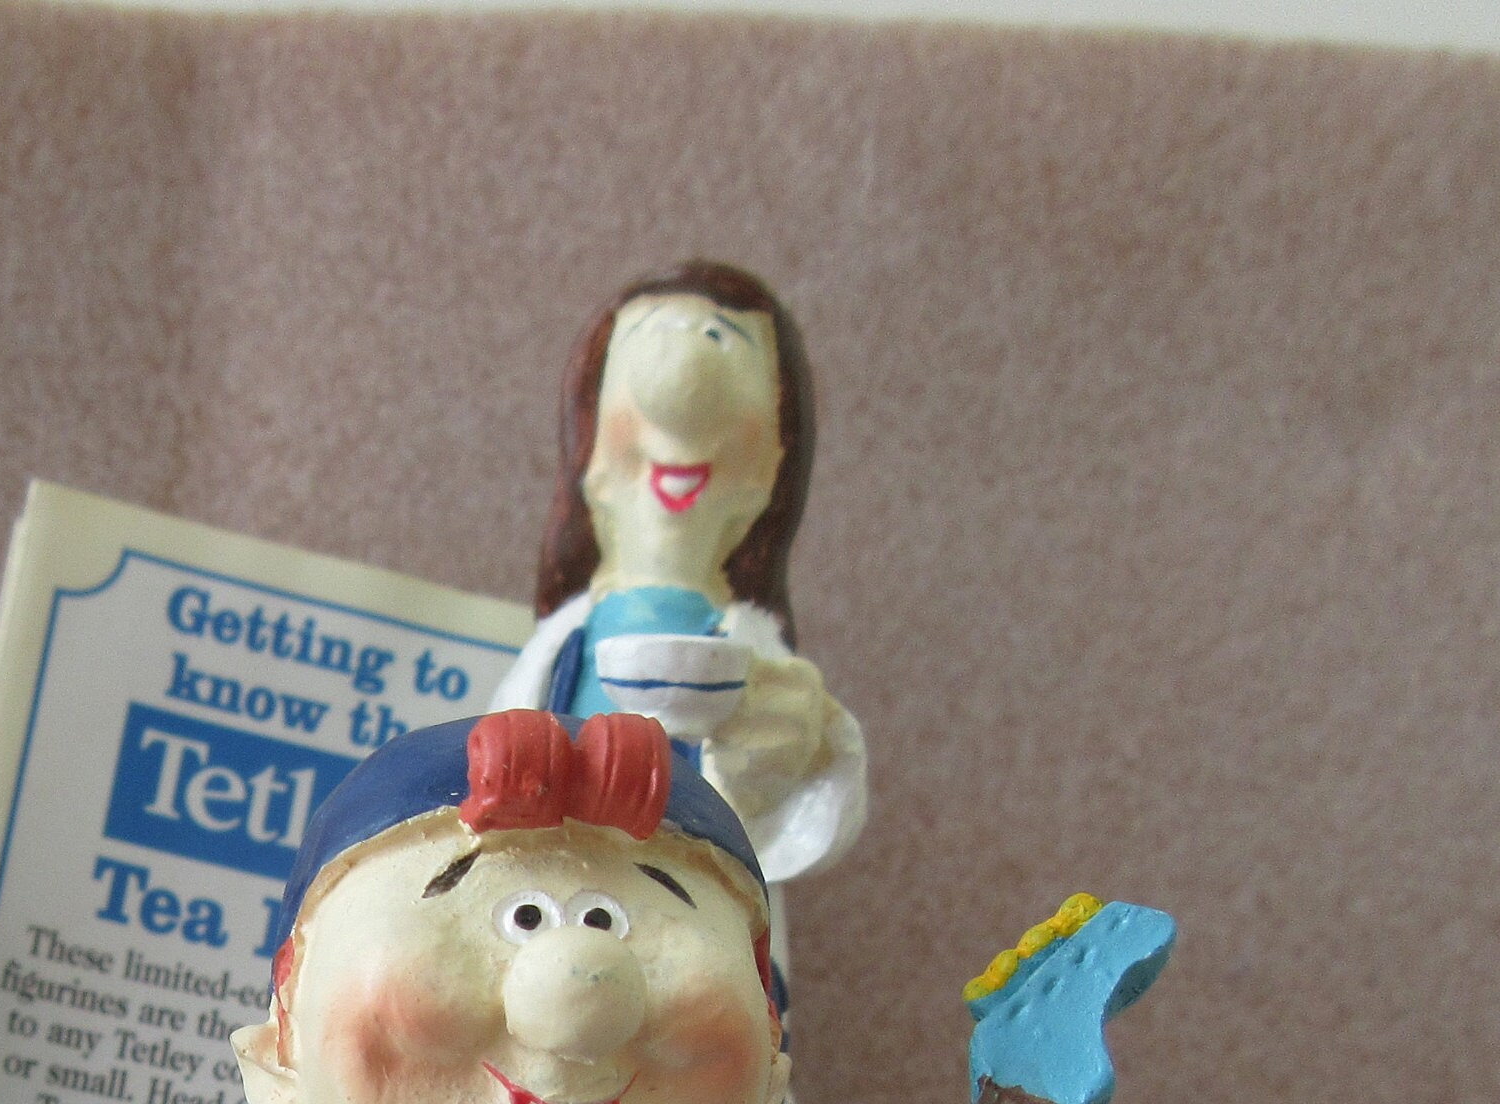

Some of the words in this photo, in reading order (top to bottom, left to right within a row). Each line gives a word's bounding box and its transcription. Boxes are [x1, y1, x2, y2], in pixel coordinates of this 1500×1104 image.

[167, 585, 396, 696] Getting
[414, 648, 470, 700] to
[166, 653, 329, 734] know
[350, 701, 409, 748] th
[140, 729, 316, 849] Tetl
[94, 856, 229, 949] Tea
[27, 925, 115, 975] These
[1, 959, 129, 1019] figurines
[138, 1004, 187, 1032] are
[3, 1055, 39, 1080] or
[46, 1064, 134, 1102] small.
[8, 1010, 38, 1038] to
[47, 1023, 104, 1059] any
[115, 1028, 206, 1082] Tetley
